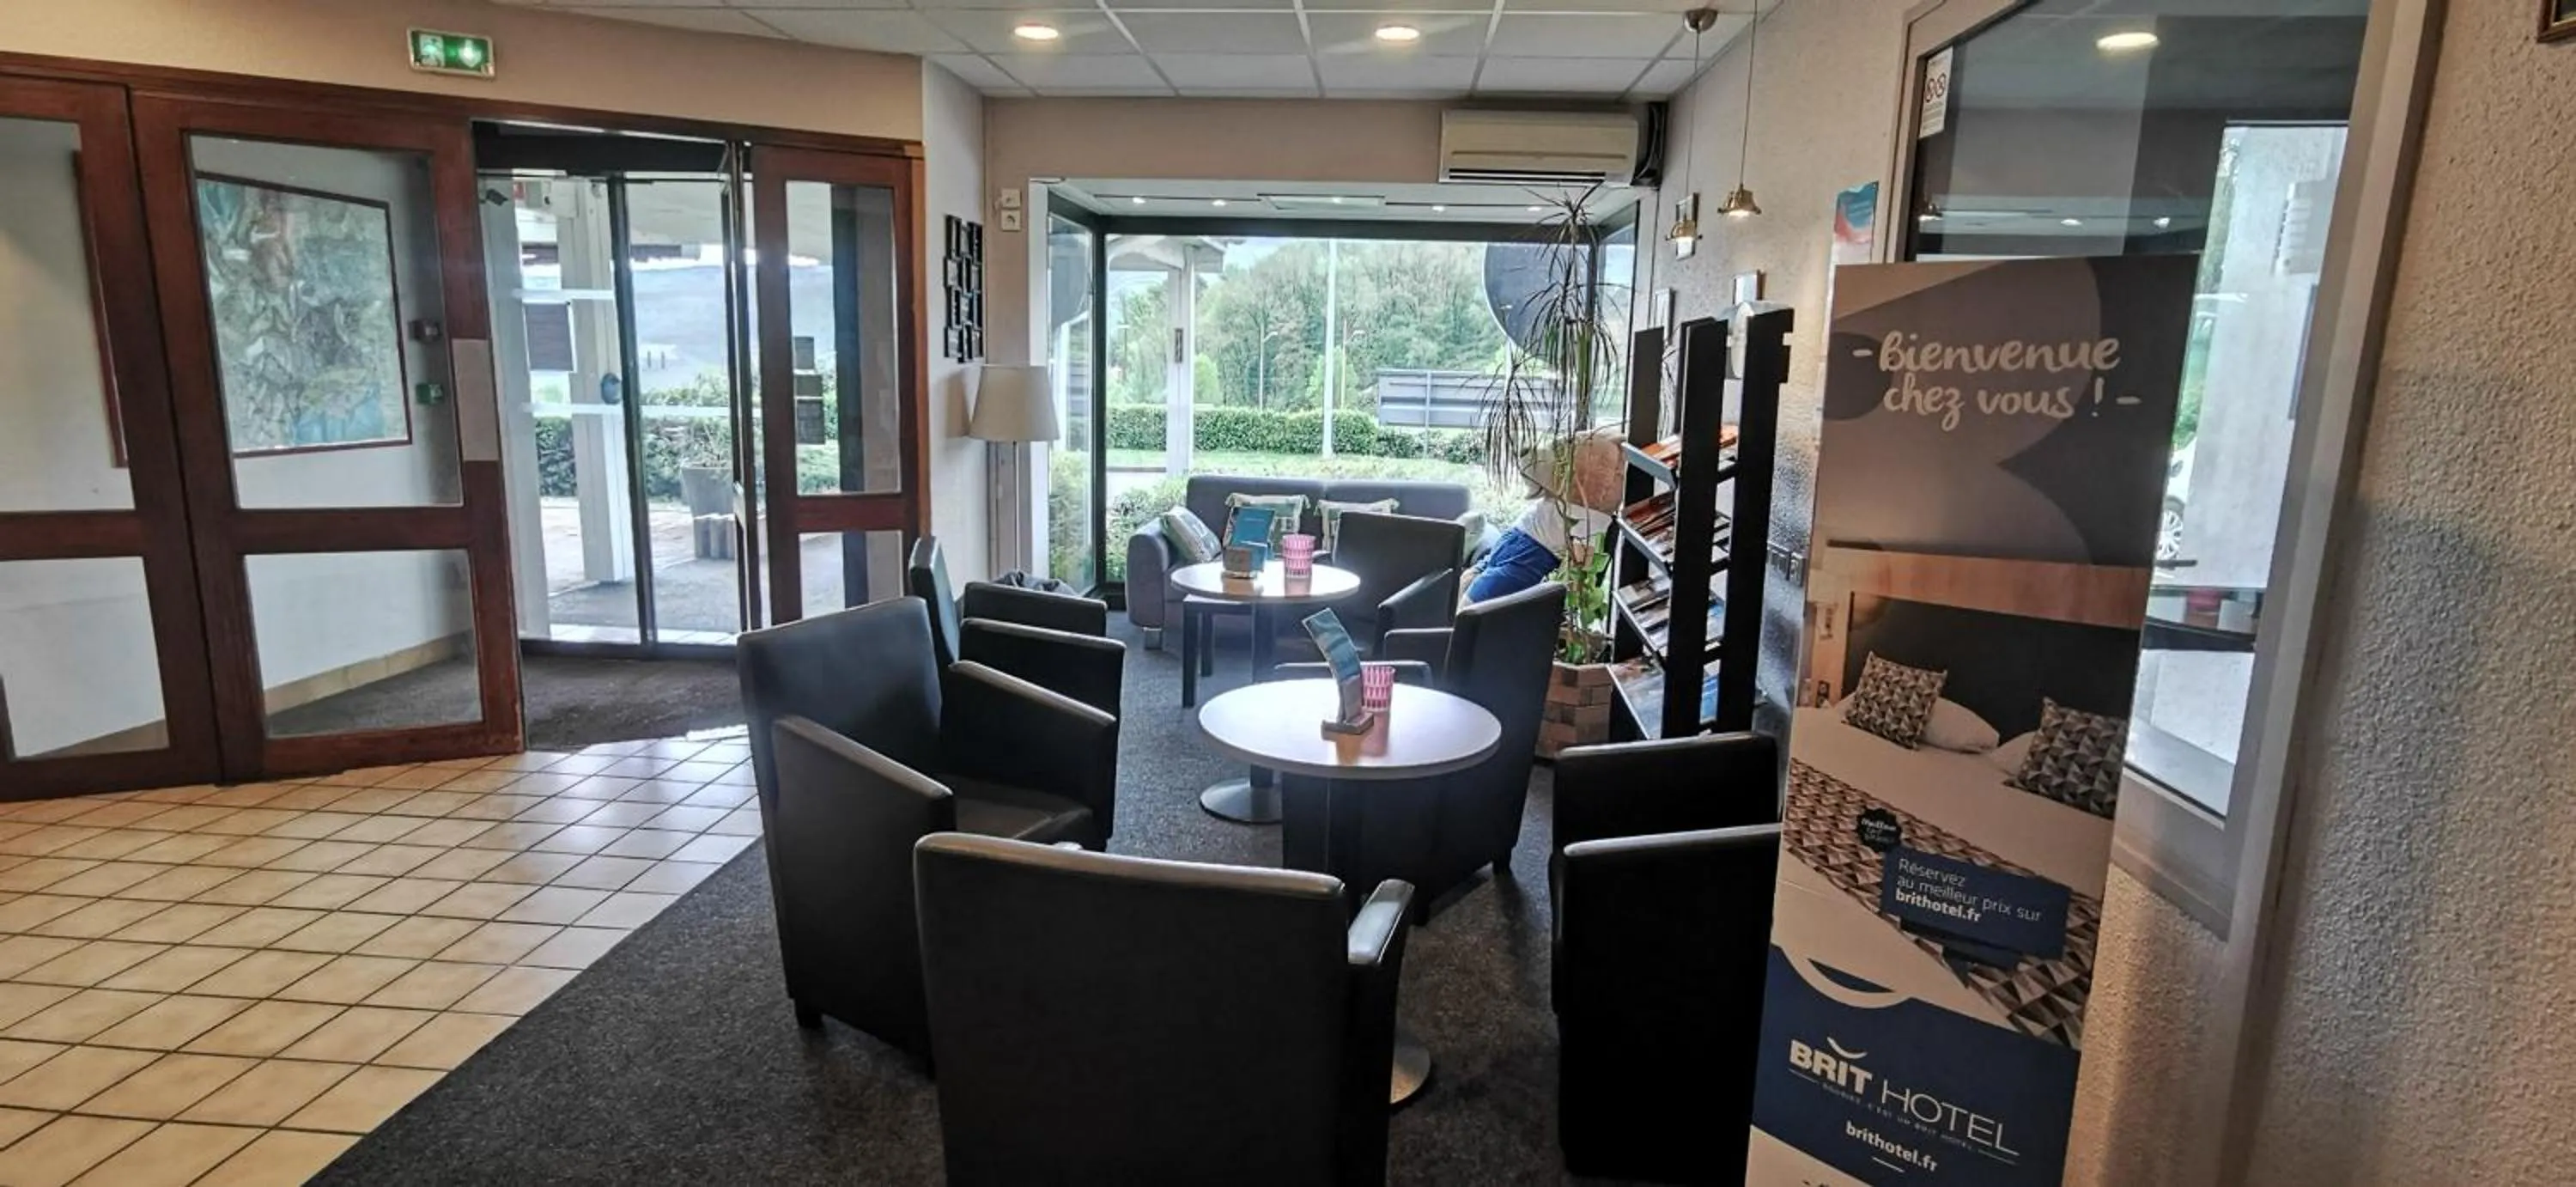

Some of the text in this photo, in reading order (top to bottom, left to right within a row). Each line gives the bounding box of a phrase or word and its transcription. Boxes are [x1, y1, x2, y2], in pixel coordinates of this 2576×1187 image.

[1883, 372, 1965, 431] chez
[1977, 387, 2075, 419] vous
[1899, 858, 1966, 887] Réservez
[1895, 887, 1982, 922] brithotel.fr
[1897, 876, 2043, 922] au meilleur prix sur
[1789, 1038, 2020, 1157] BRIT HOTEL
[1845, 1120, 1938, 1172] brithotel.fr
